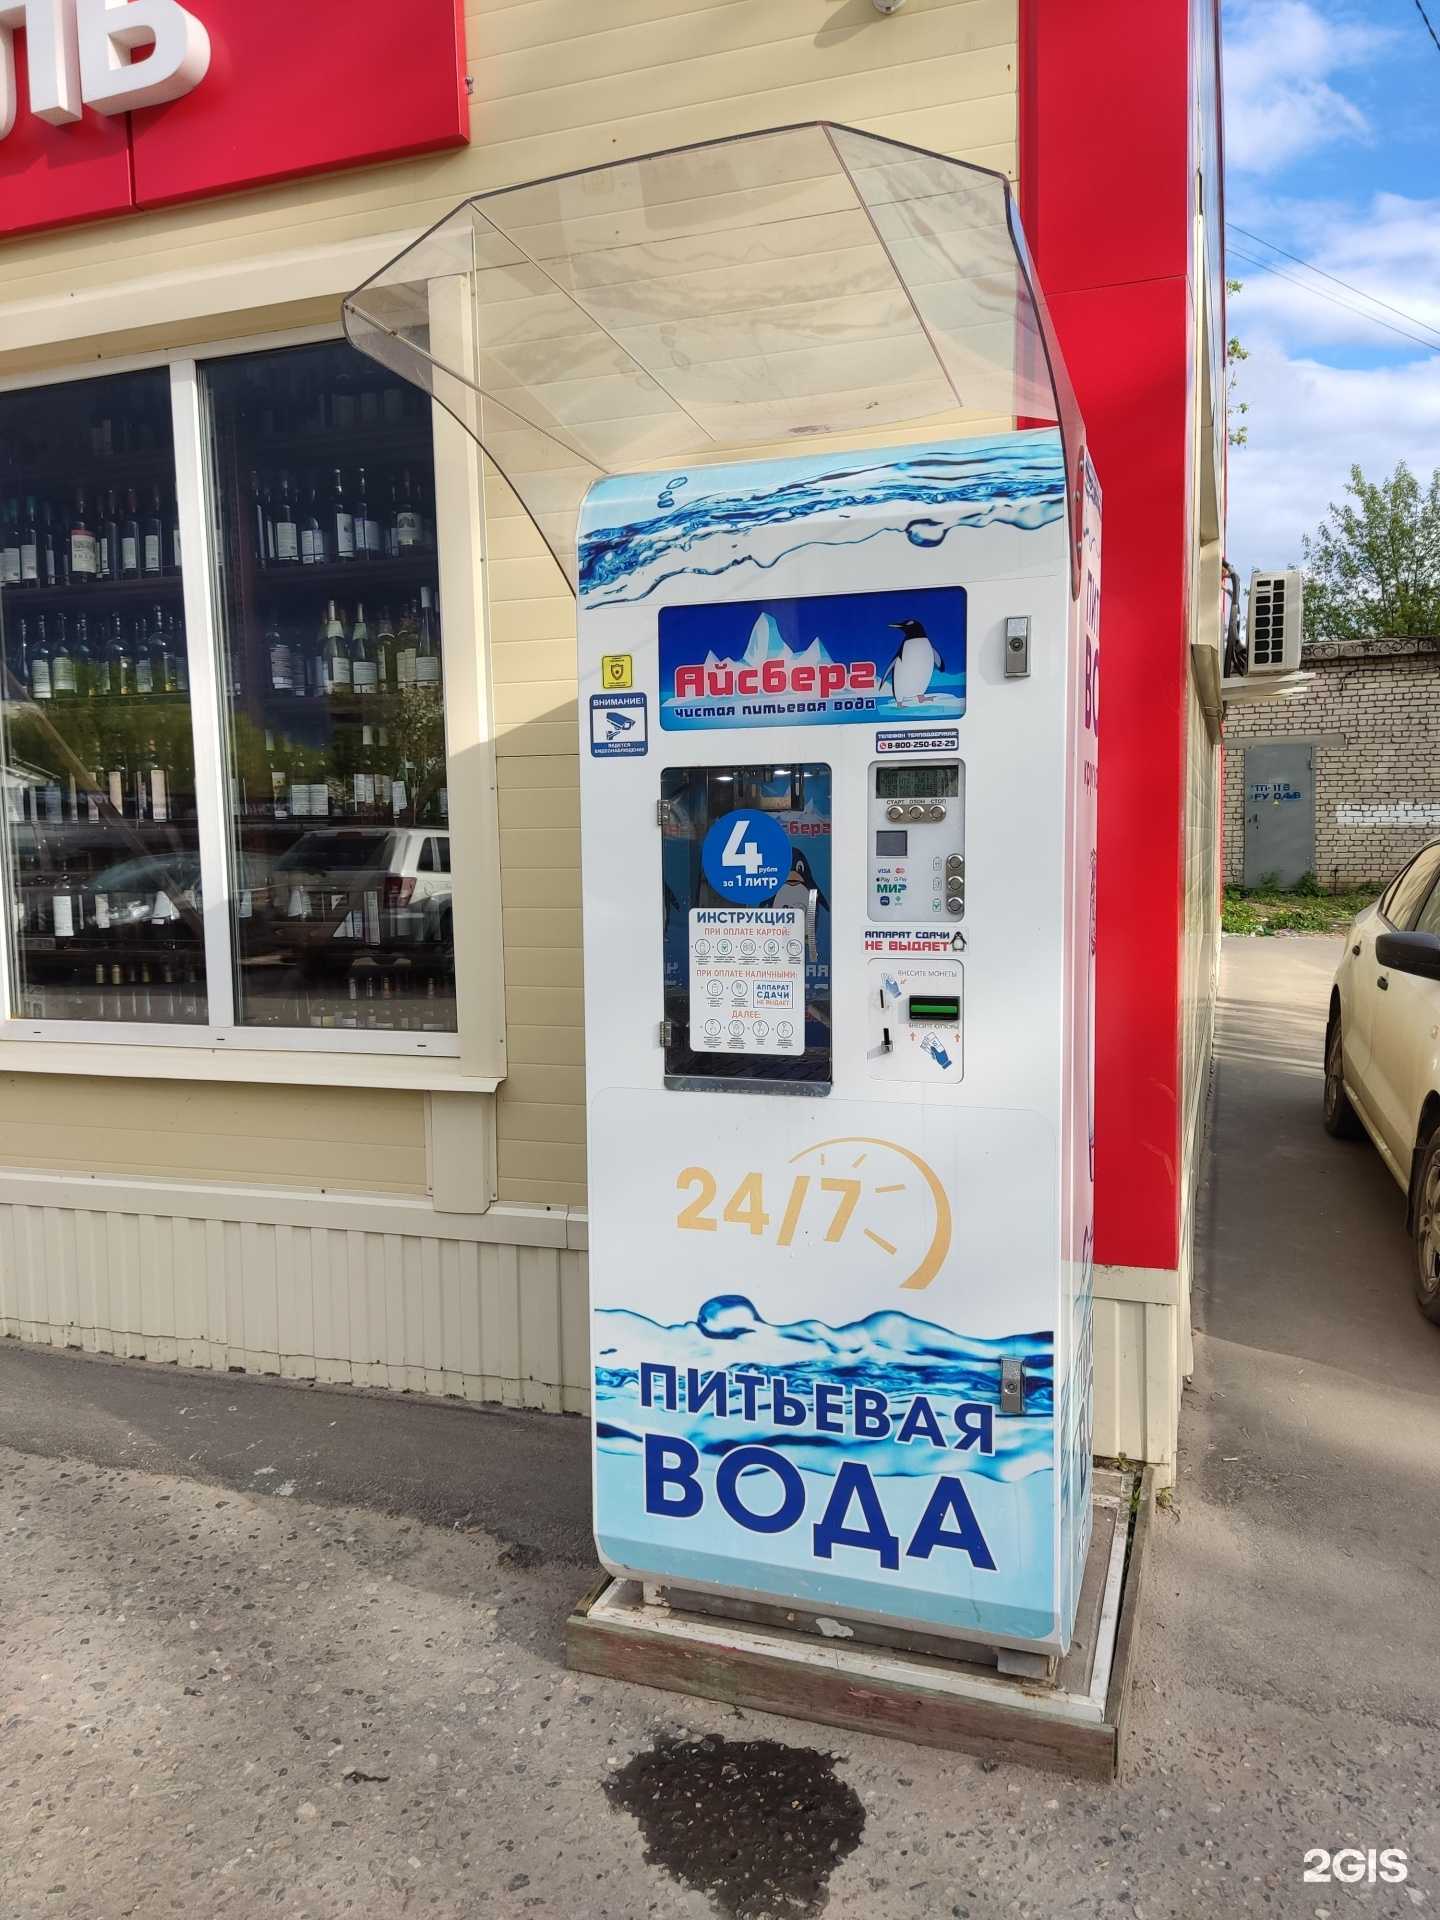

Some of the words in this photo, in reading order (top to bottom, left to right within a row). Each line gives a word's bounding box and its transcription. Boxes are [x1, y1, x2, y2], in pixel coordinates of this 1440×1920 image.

[675, 659, 875, 699] Айсберг
[593, 697, 644, 707] ВНИМАНИЕ!
[675, 706, 736, 719] чистая
[742, 701, 827, 716] питьевая
[833, 697, 876, 712] вода
[721, 820, 763, 875] 4
[735, 875, 743, 887] 1
[744, 876, 779, 889] литр
[876, 883, 907, 894] МИР
[696, 911, 796, 925] ИНСТРУКЦИЯ
[704, 927, 721, 936] ПРИ
[723, 927, 754, 936] ОПЛАТЕ
[865, 931, 911, 939] АППАРАТ
[915, 931, 950, 939] СДАЧИ
[865, 940, 883, 951] НЕ
[888, 941, 949, 952] ВЫДАЕТ
[696, 969, 712, 977] ПРИ
[713, 969, 743, 978] ОПЛАТЕ
[897, 969, 927, 977] ВНЕСИТЕ
[757, 991, 790, 1000] СДАЧИ
[676, 1167, 861, 1246] 24/7
[640, 1361, 994, 1455] ПИТЬЕВАЯ
[644, 1433, 998, 1572] ВОДА
